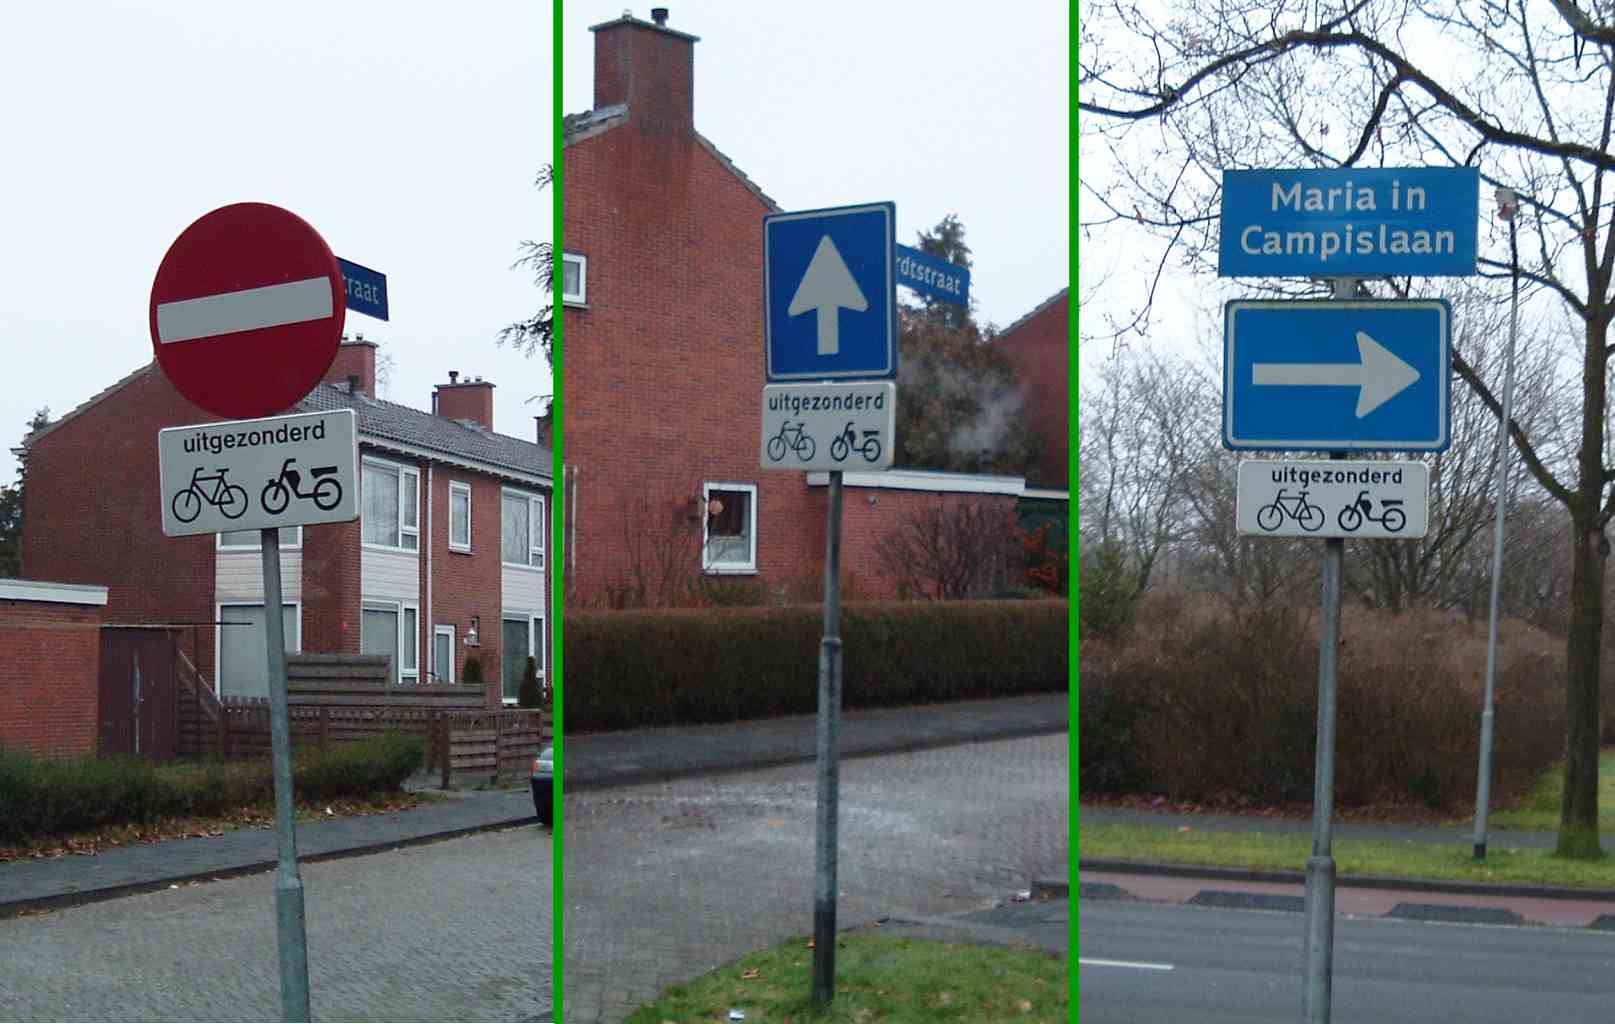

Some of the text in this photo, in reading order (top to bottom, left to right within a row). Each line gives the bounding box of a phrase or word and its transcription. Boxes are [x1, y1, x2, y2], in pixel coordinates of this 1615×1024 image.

[1271, 180, 1425, 212] Maria in
[1241, 225, 1455, 261] Campislaan
[769, 391, 884, 414] uitgezonderd
[183, 420, 326, 454] uitgezonderd
[1271, 467, 1403, 488] uitgezonderd
